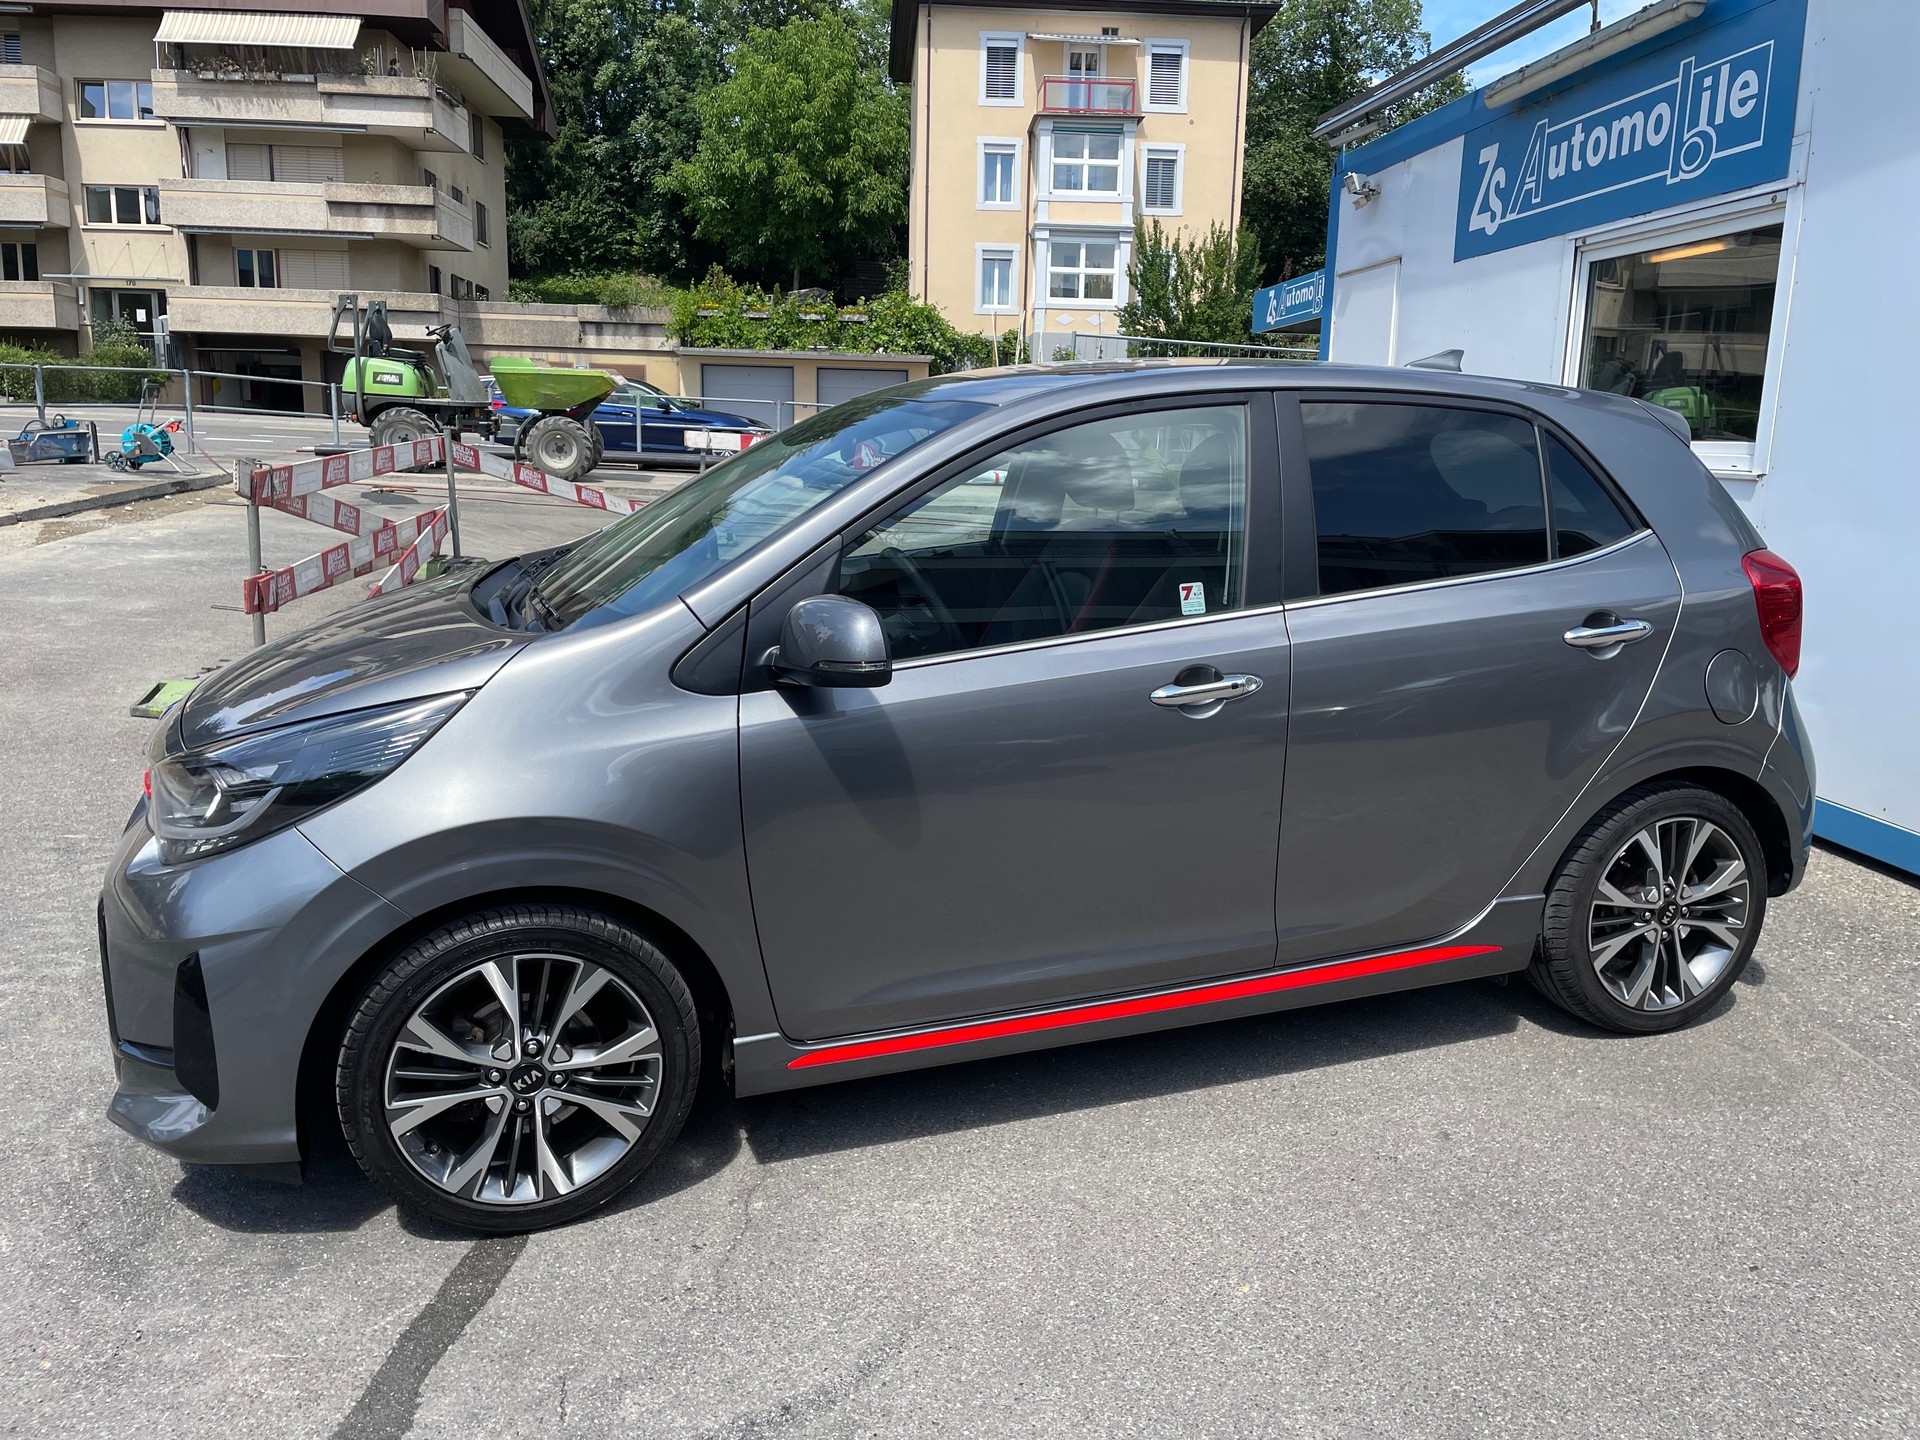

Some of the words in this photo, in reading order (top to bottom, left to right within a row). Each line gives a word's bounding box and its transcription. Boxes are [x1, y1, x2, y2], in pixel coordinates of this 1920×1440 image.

[1468, 142, 1507, 236] Zs
[1506, 55, 1759, 218] Automobile
[1277, 272, 1325, 320] Automobil
[1661, 905, 1676, 924] KIA
[513, 1069, 543, 1091] KIA
